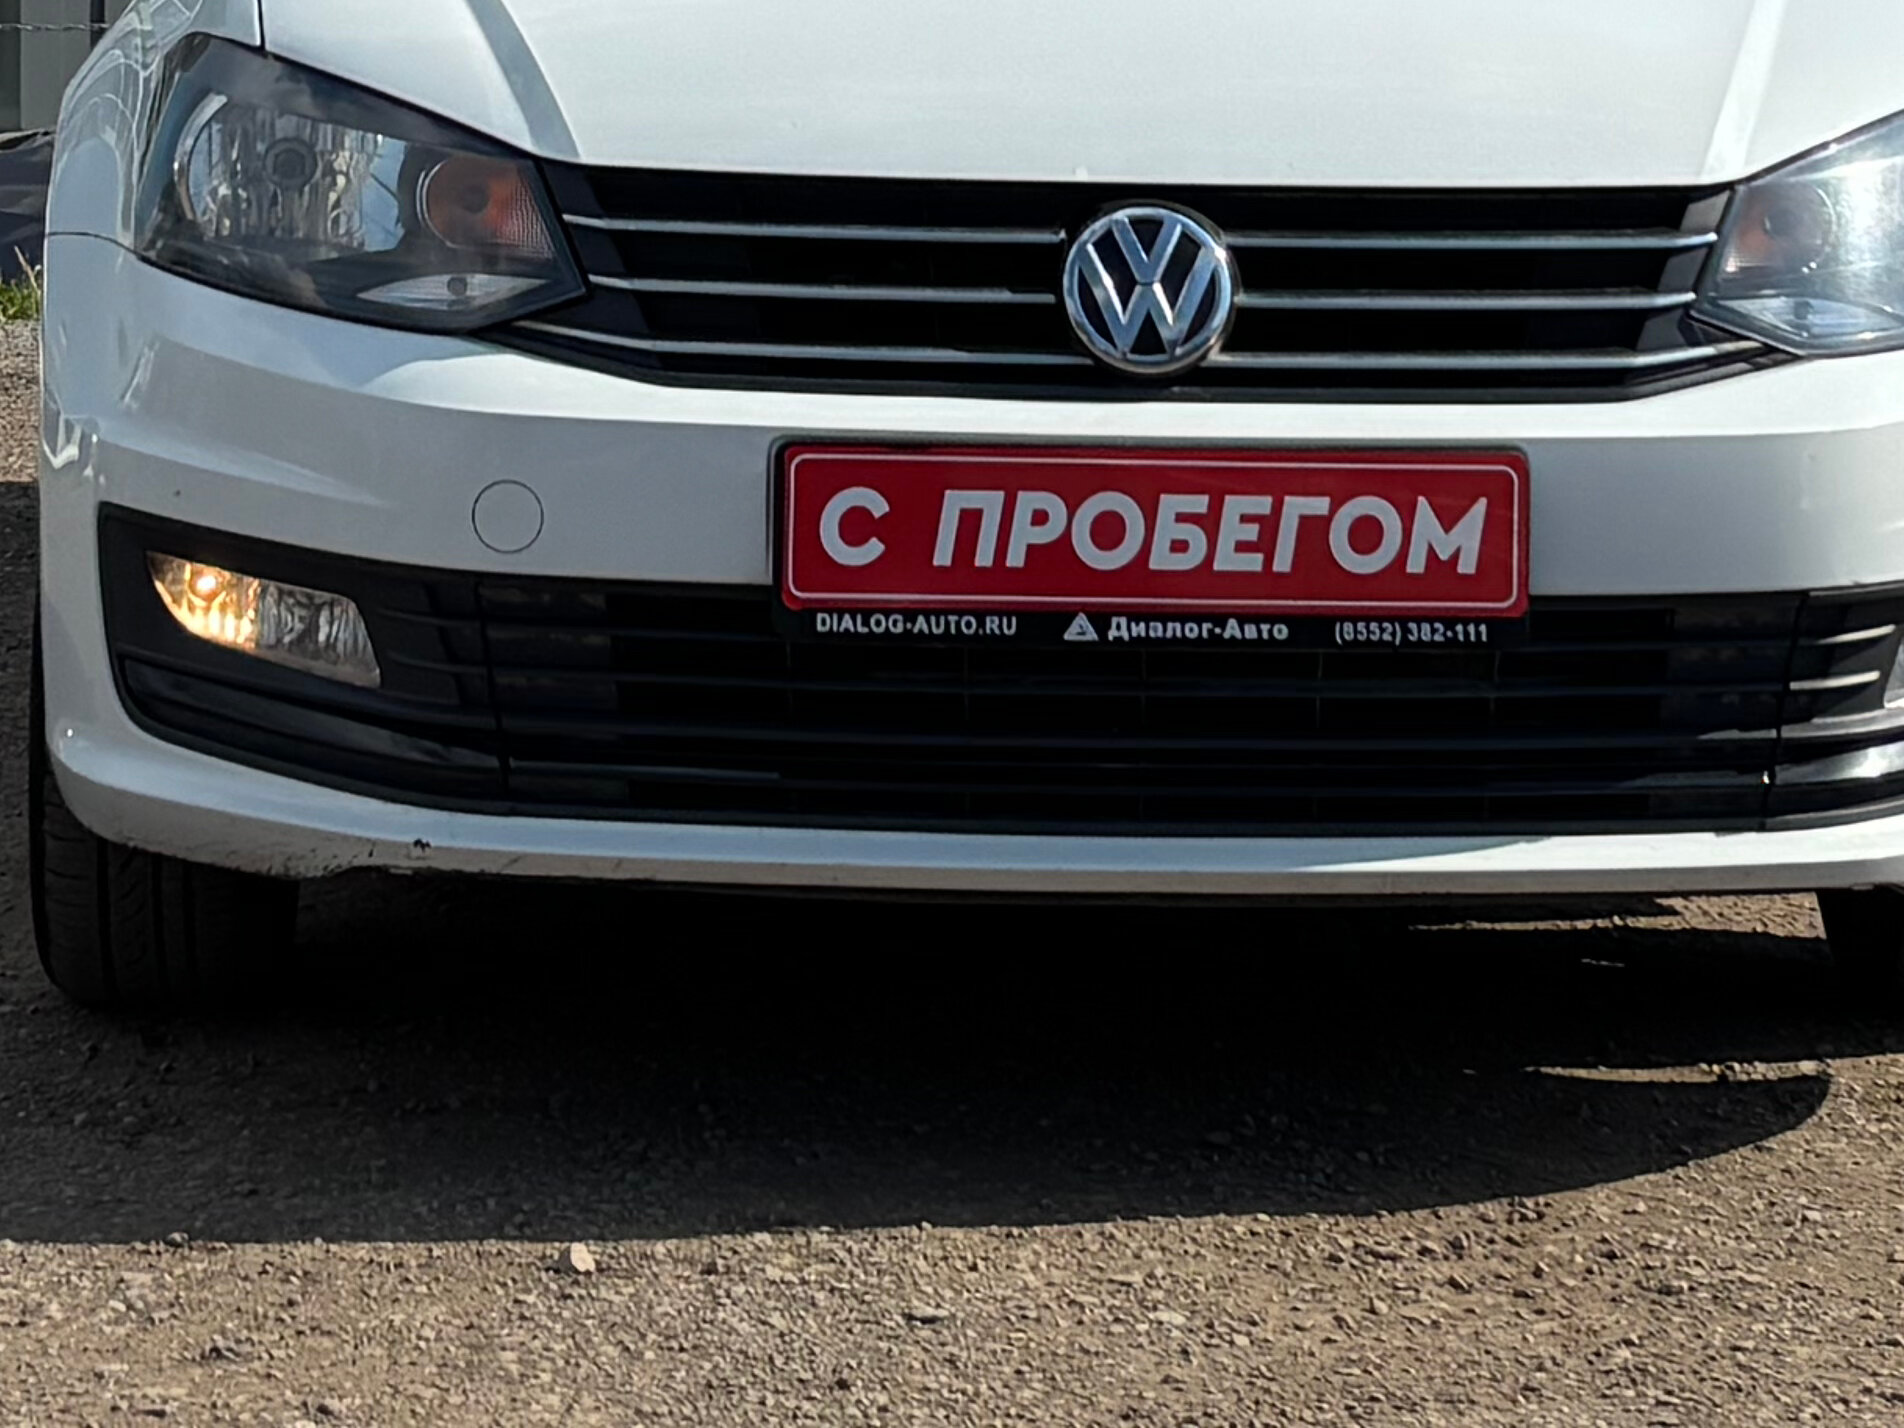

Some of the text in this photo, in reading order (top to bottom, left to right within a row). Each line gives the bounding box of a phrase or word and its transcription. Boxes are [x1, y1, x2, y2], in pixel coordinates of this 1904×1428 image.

[819, 486, 1488, 575] С ПРОБЕГОМ
[816, 612, 1018, 636] DIALOG-AUTO.RU
[1107, 615, 1290, 642] Диалог-Авто
[1335, 621, 1488, 646] (8552) 382-111
